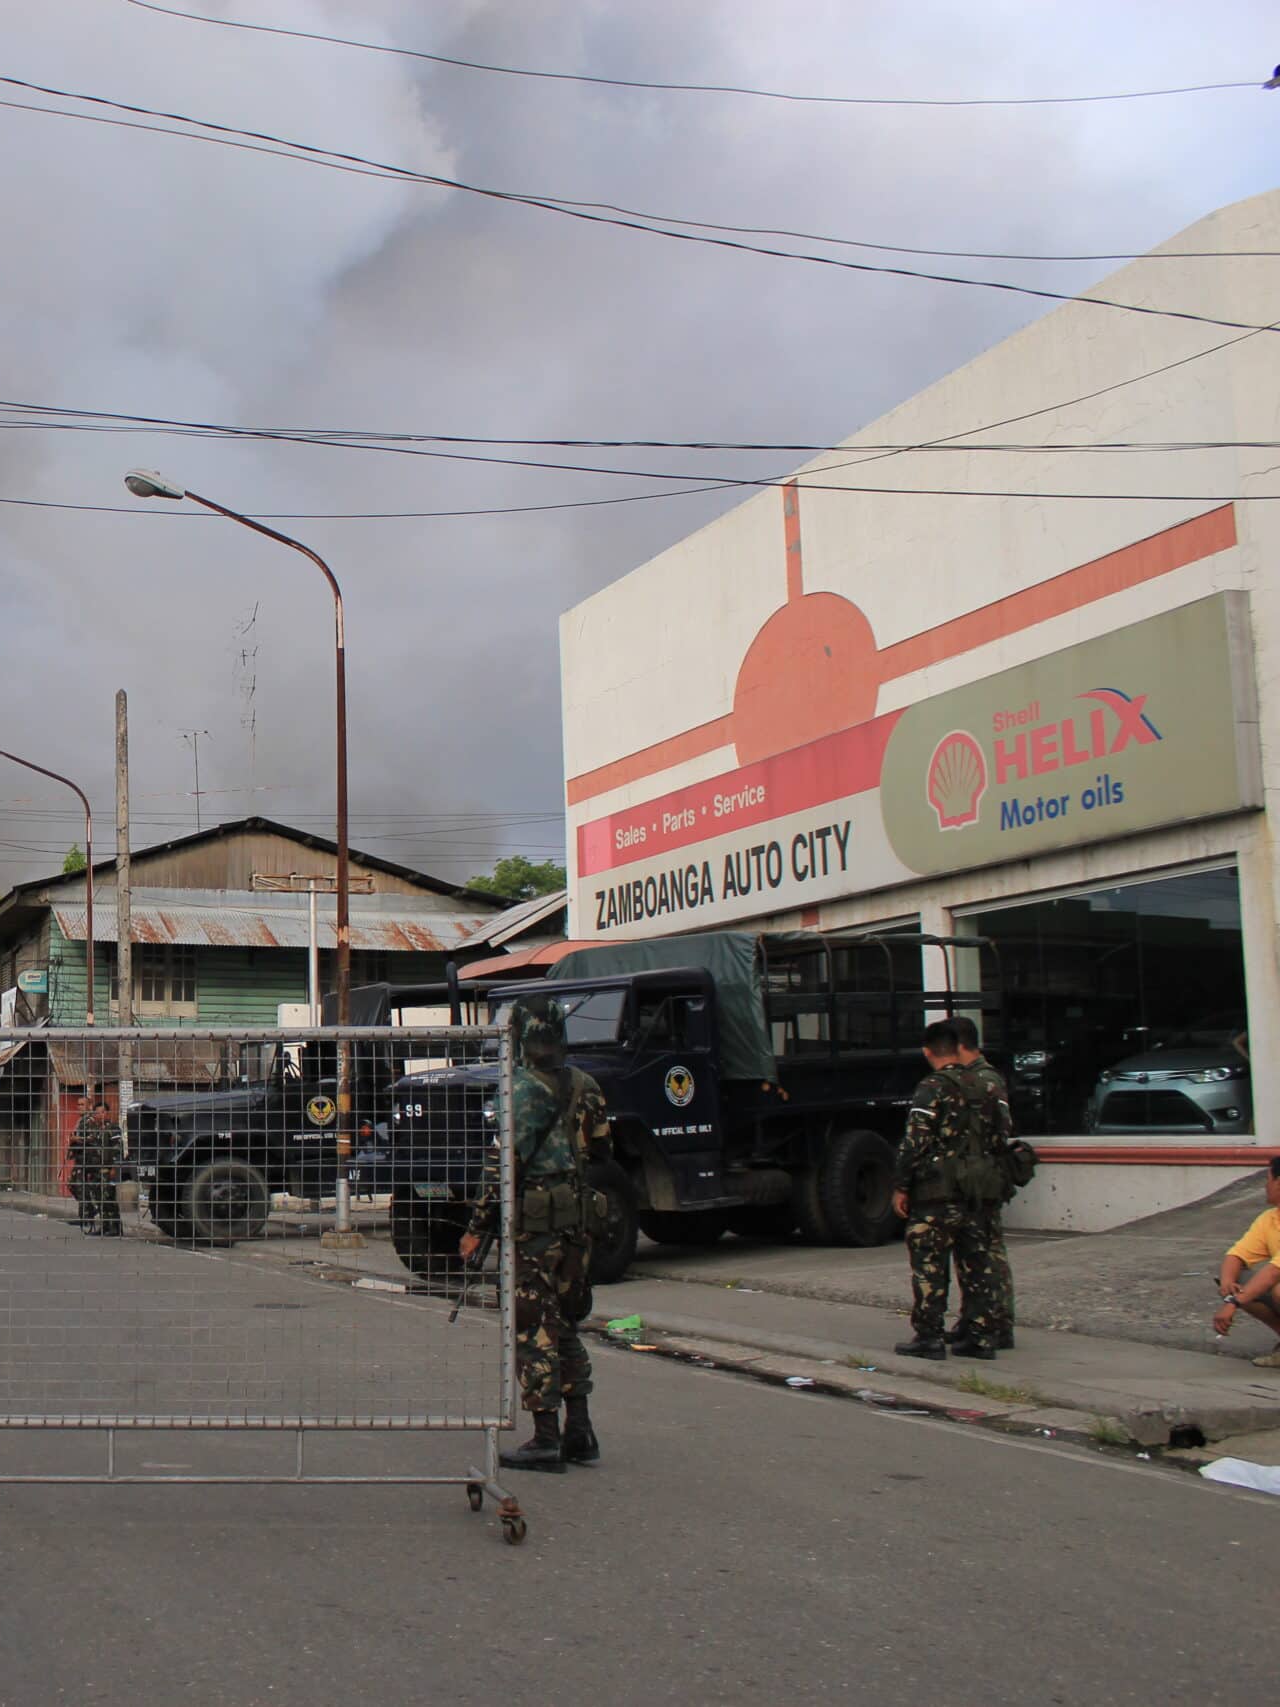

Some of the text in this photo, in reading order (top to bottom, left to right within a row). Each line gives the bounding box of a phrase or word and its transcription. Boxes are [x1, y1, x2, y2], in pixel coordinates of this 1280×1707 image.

[992, 700, 1041, 733] Shell
[993, 688, 1162, 785] HELIX
[615, 784, 766, 850] Sales Parts Service
[1000, 774, 1124, 832] Motor oils
[594, 820, 852, 931] ZAMBOANGA AUTO CITY
[405, 1103, 423, 1118] 99
